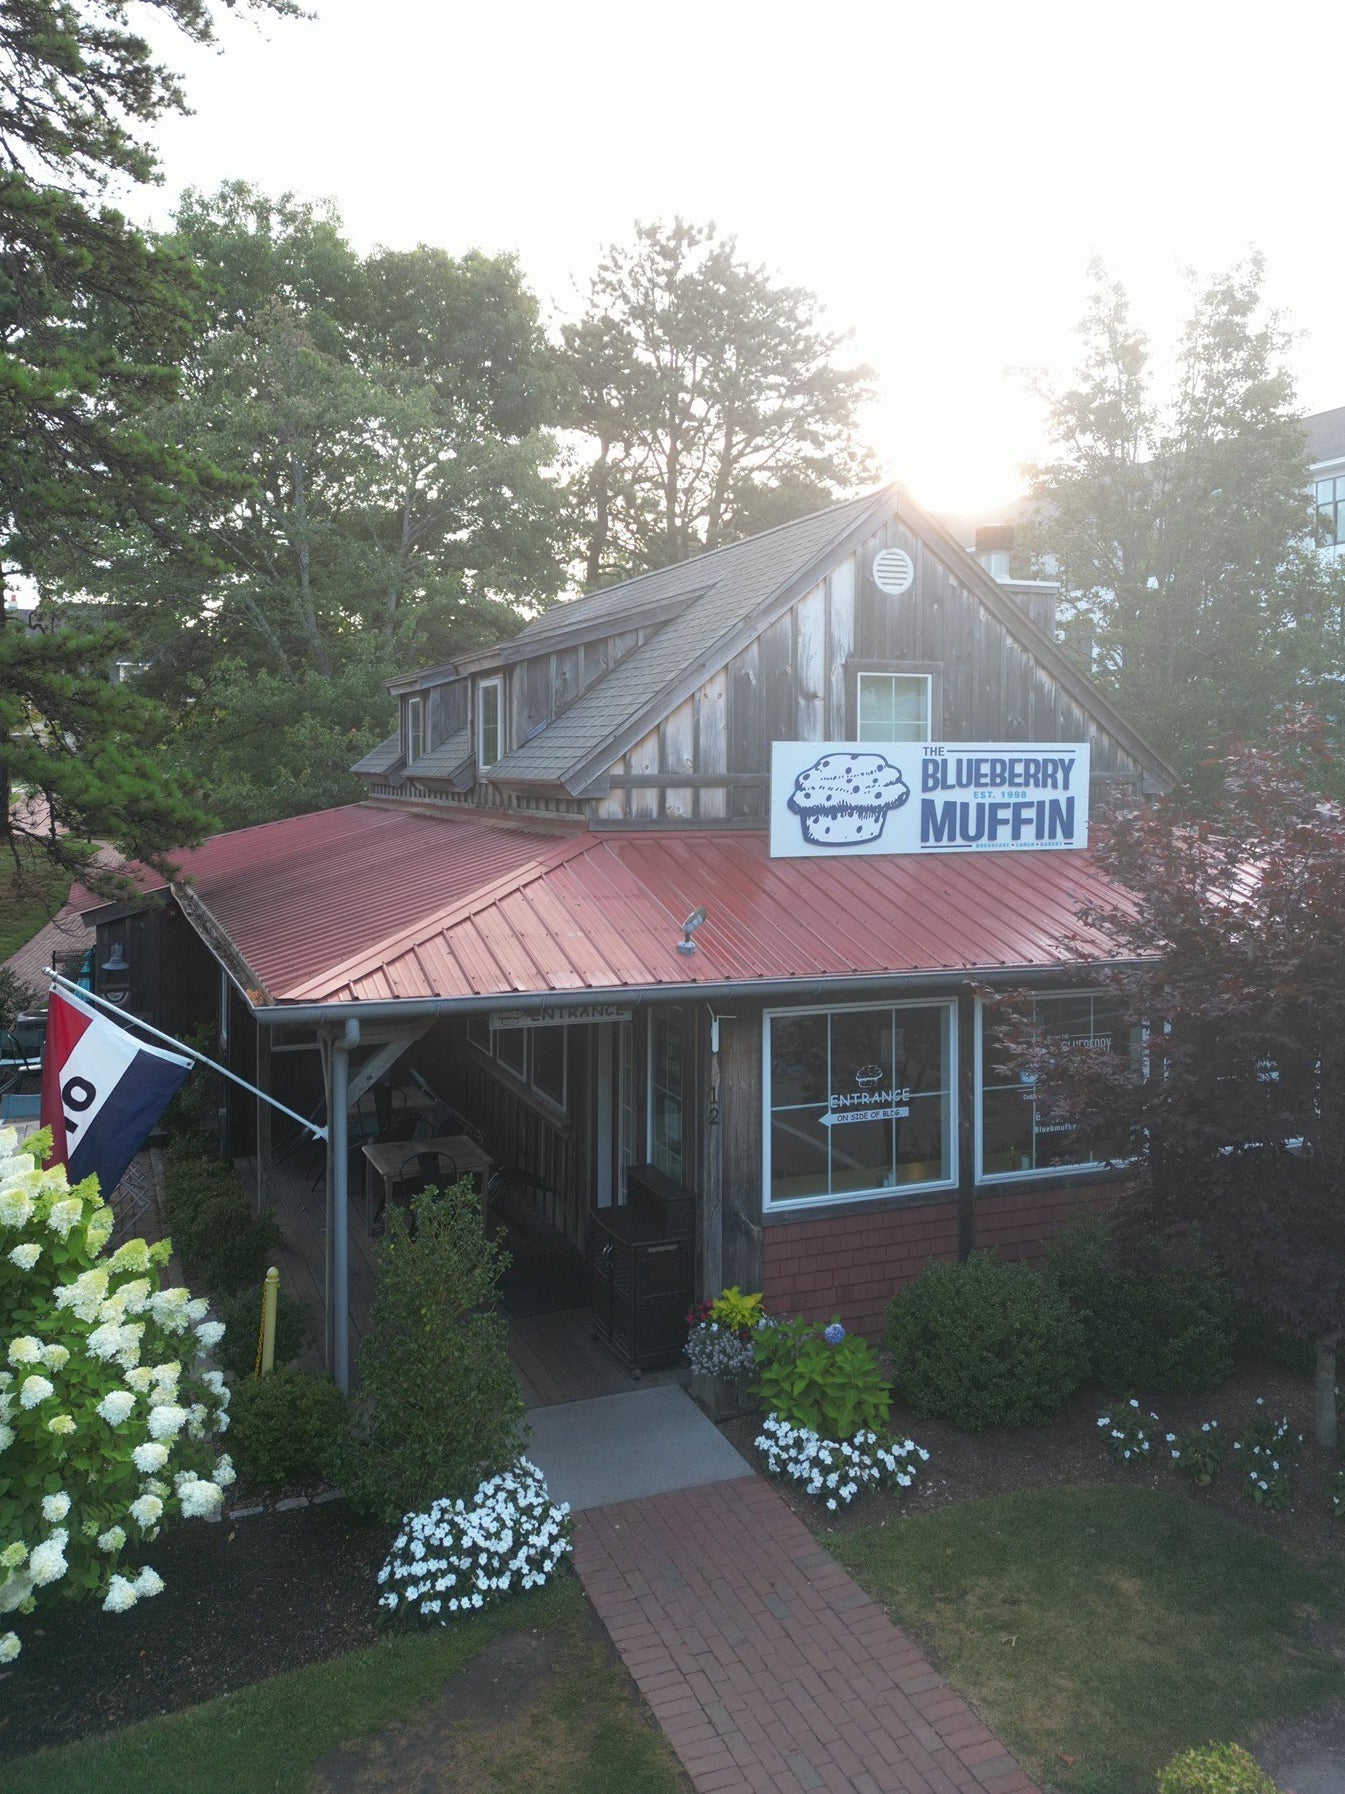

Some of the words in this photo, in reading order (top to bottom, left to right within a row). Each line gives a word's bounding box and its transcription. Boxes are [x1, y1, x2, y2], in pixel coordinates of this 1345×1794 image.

[923, 747, 945, 757] THE
[922, 758, 1075, 793] BLUEBERRY
[973, 790, 996, 800] EST.
[1000, 790, 1027, 799] 1998
[920, 796, 1075, 843] MUFFIN
[830, 1088, 910, 1108] ENTRANCE
[837, 1113, 849, 1122] ON
[851, 1111, 868, 1121] SIDE
[870, 1110, 880, 1119] OF
